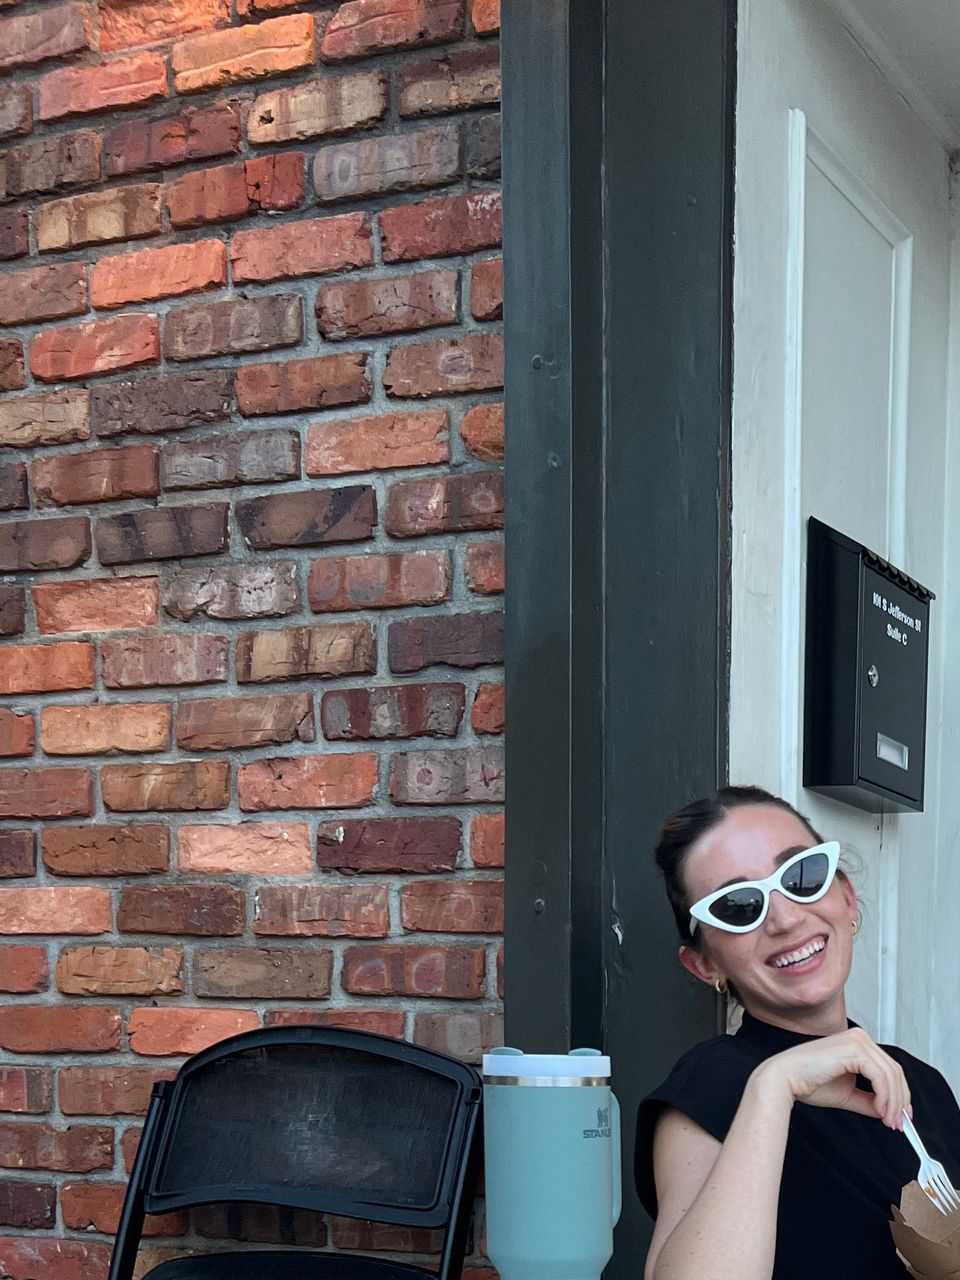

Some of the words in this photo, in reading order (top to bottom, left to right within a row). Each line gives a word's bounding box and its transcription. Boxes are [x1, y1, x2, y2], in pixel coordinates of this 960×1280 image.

[882, 598, 887, 611] S
[888, 602, 914, 629] Jefferson
[887, 624, 901, 642] Suite
[902, 633, 908, 645] C
